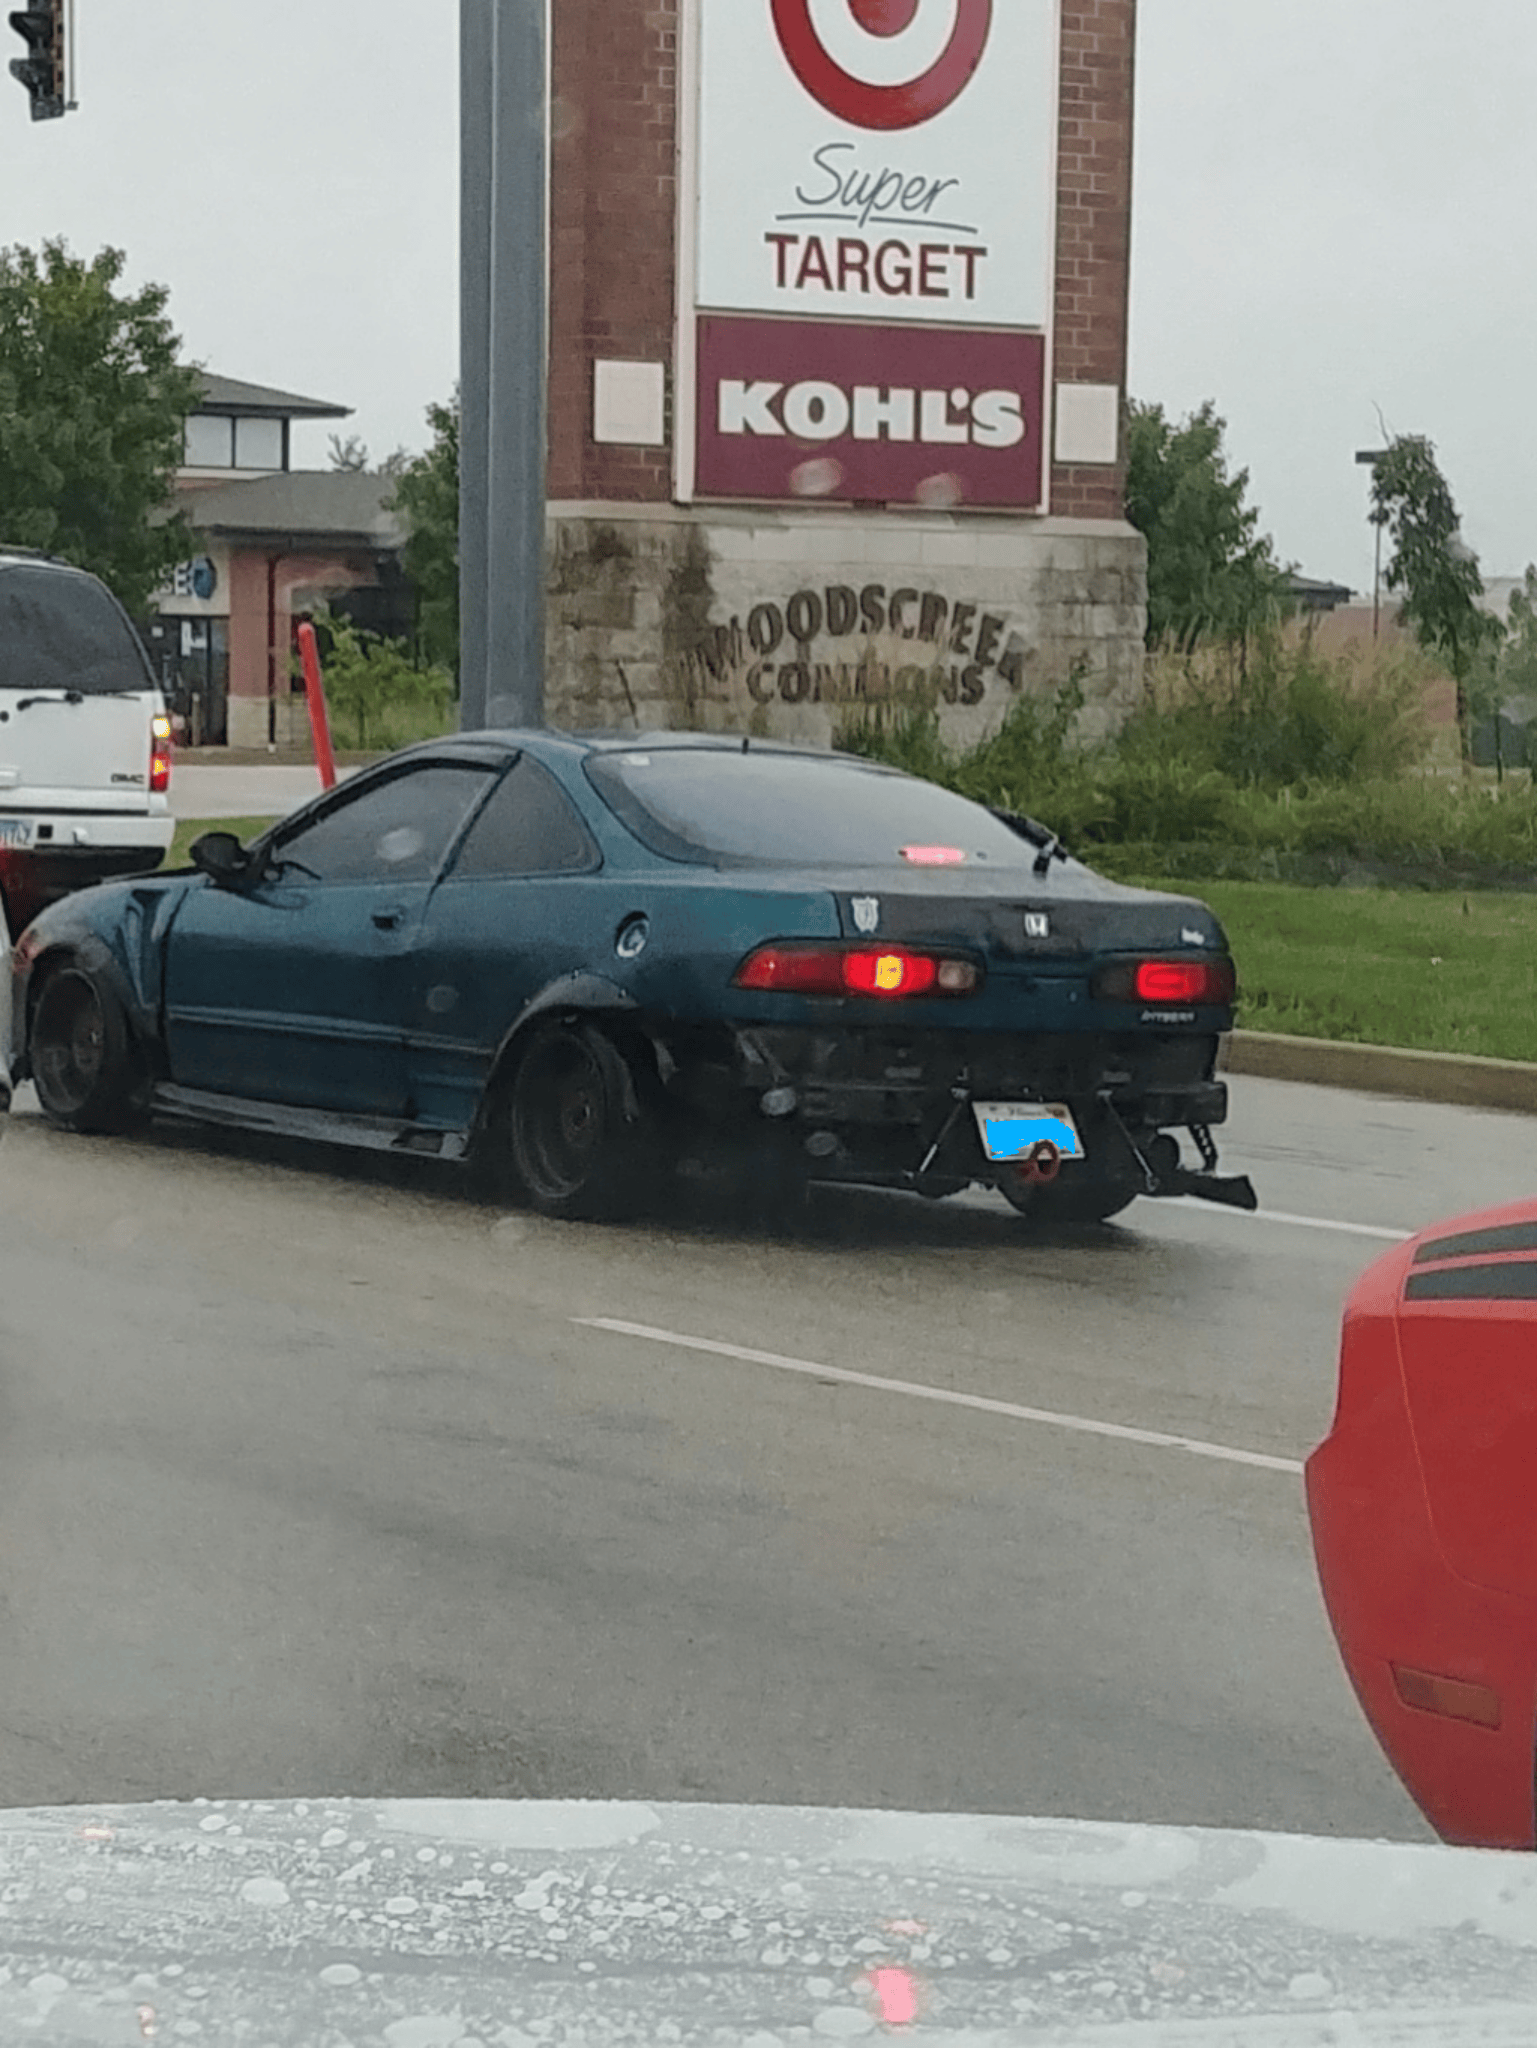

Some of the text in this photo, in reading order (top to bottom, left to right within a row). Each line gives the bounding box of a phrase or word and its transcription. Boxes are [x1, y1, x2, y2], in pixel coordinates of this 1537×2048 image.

[796, 143, 960, 228] Super
[764, 232, 988, 300] TARGET
[718, 378, 1026, 448] KOHL'S
